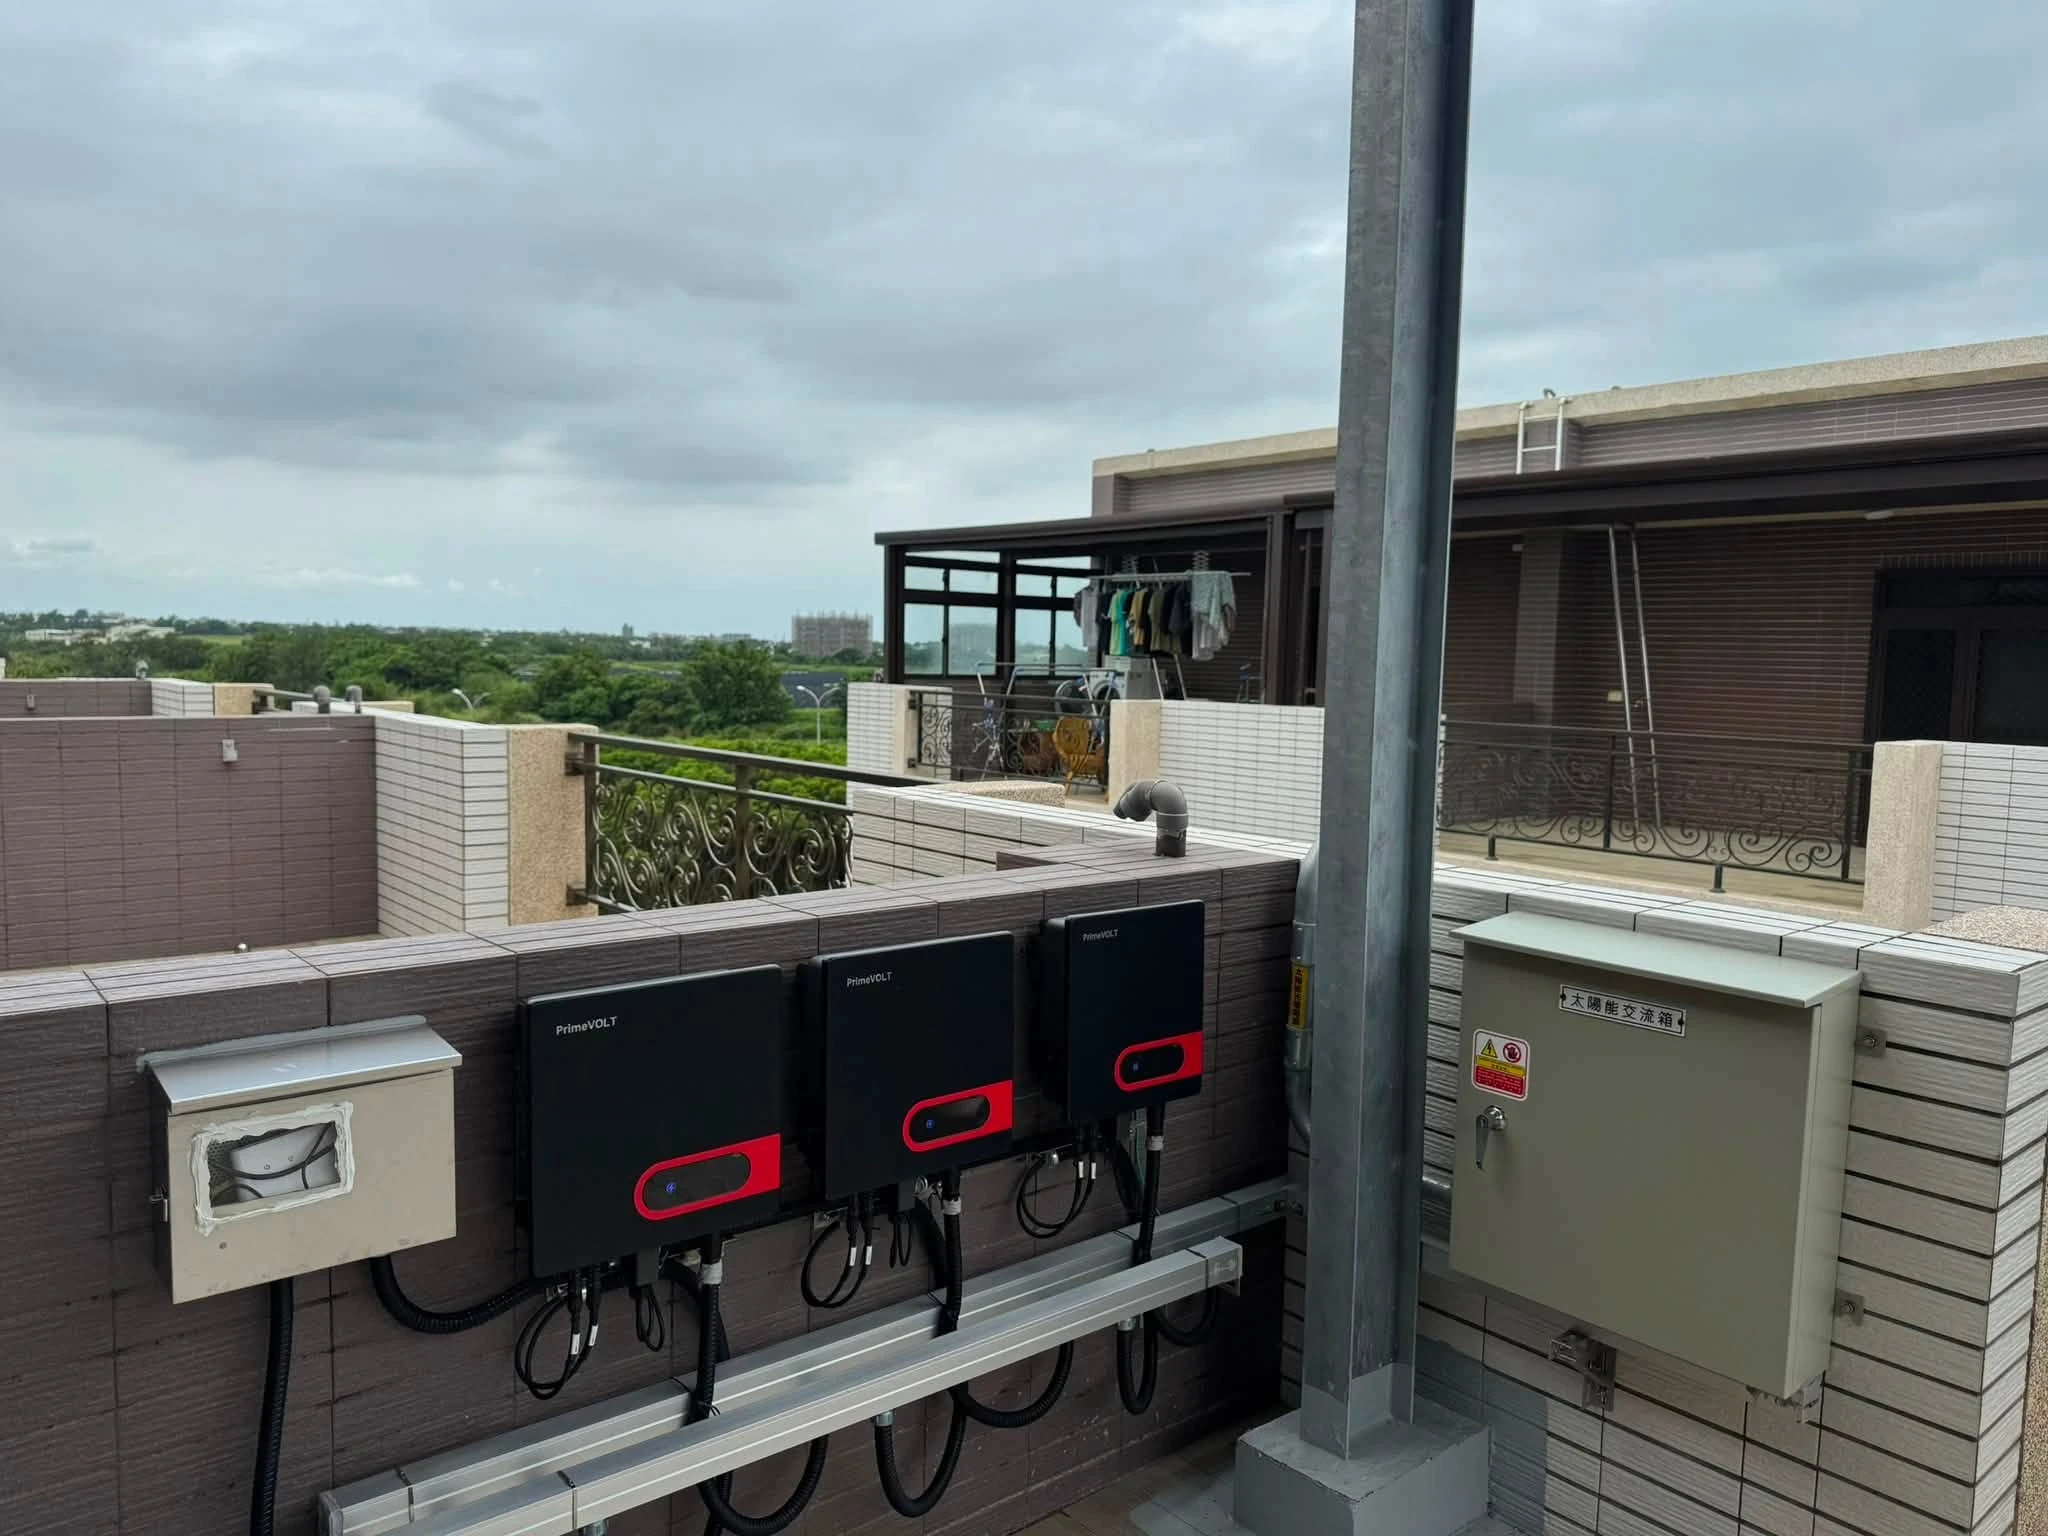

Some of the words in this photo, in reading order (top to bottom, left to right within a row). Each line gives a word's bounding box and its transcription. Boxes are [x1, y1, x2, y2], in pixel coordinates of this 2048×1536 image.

[846, 971, 893, 987] PrimeVOLT
[1570, 992, 1674, 1028] 太陽能交流箱
[555, 1015, 618, 1035] PrimeVOLT
